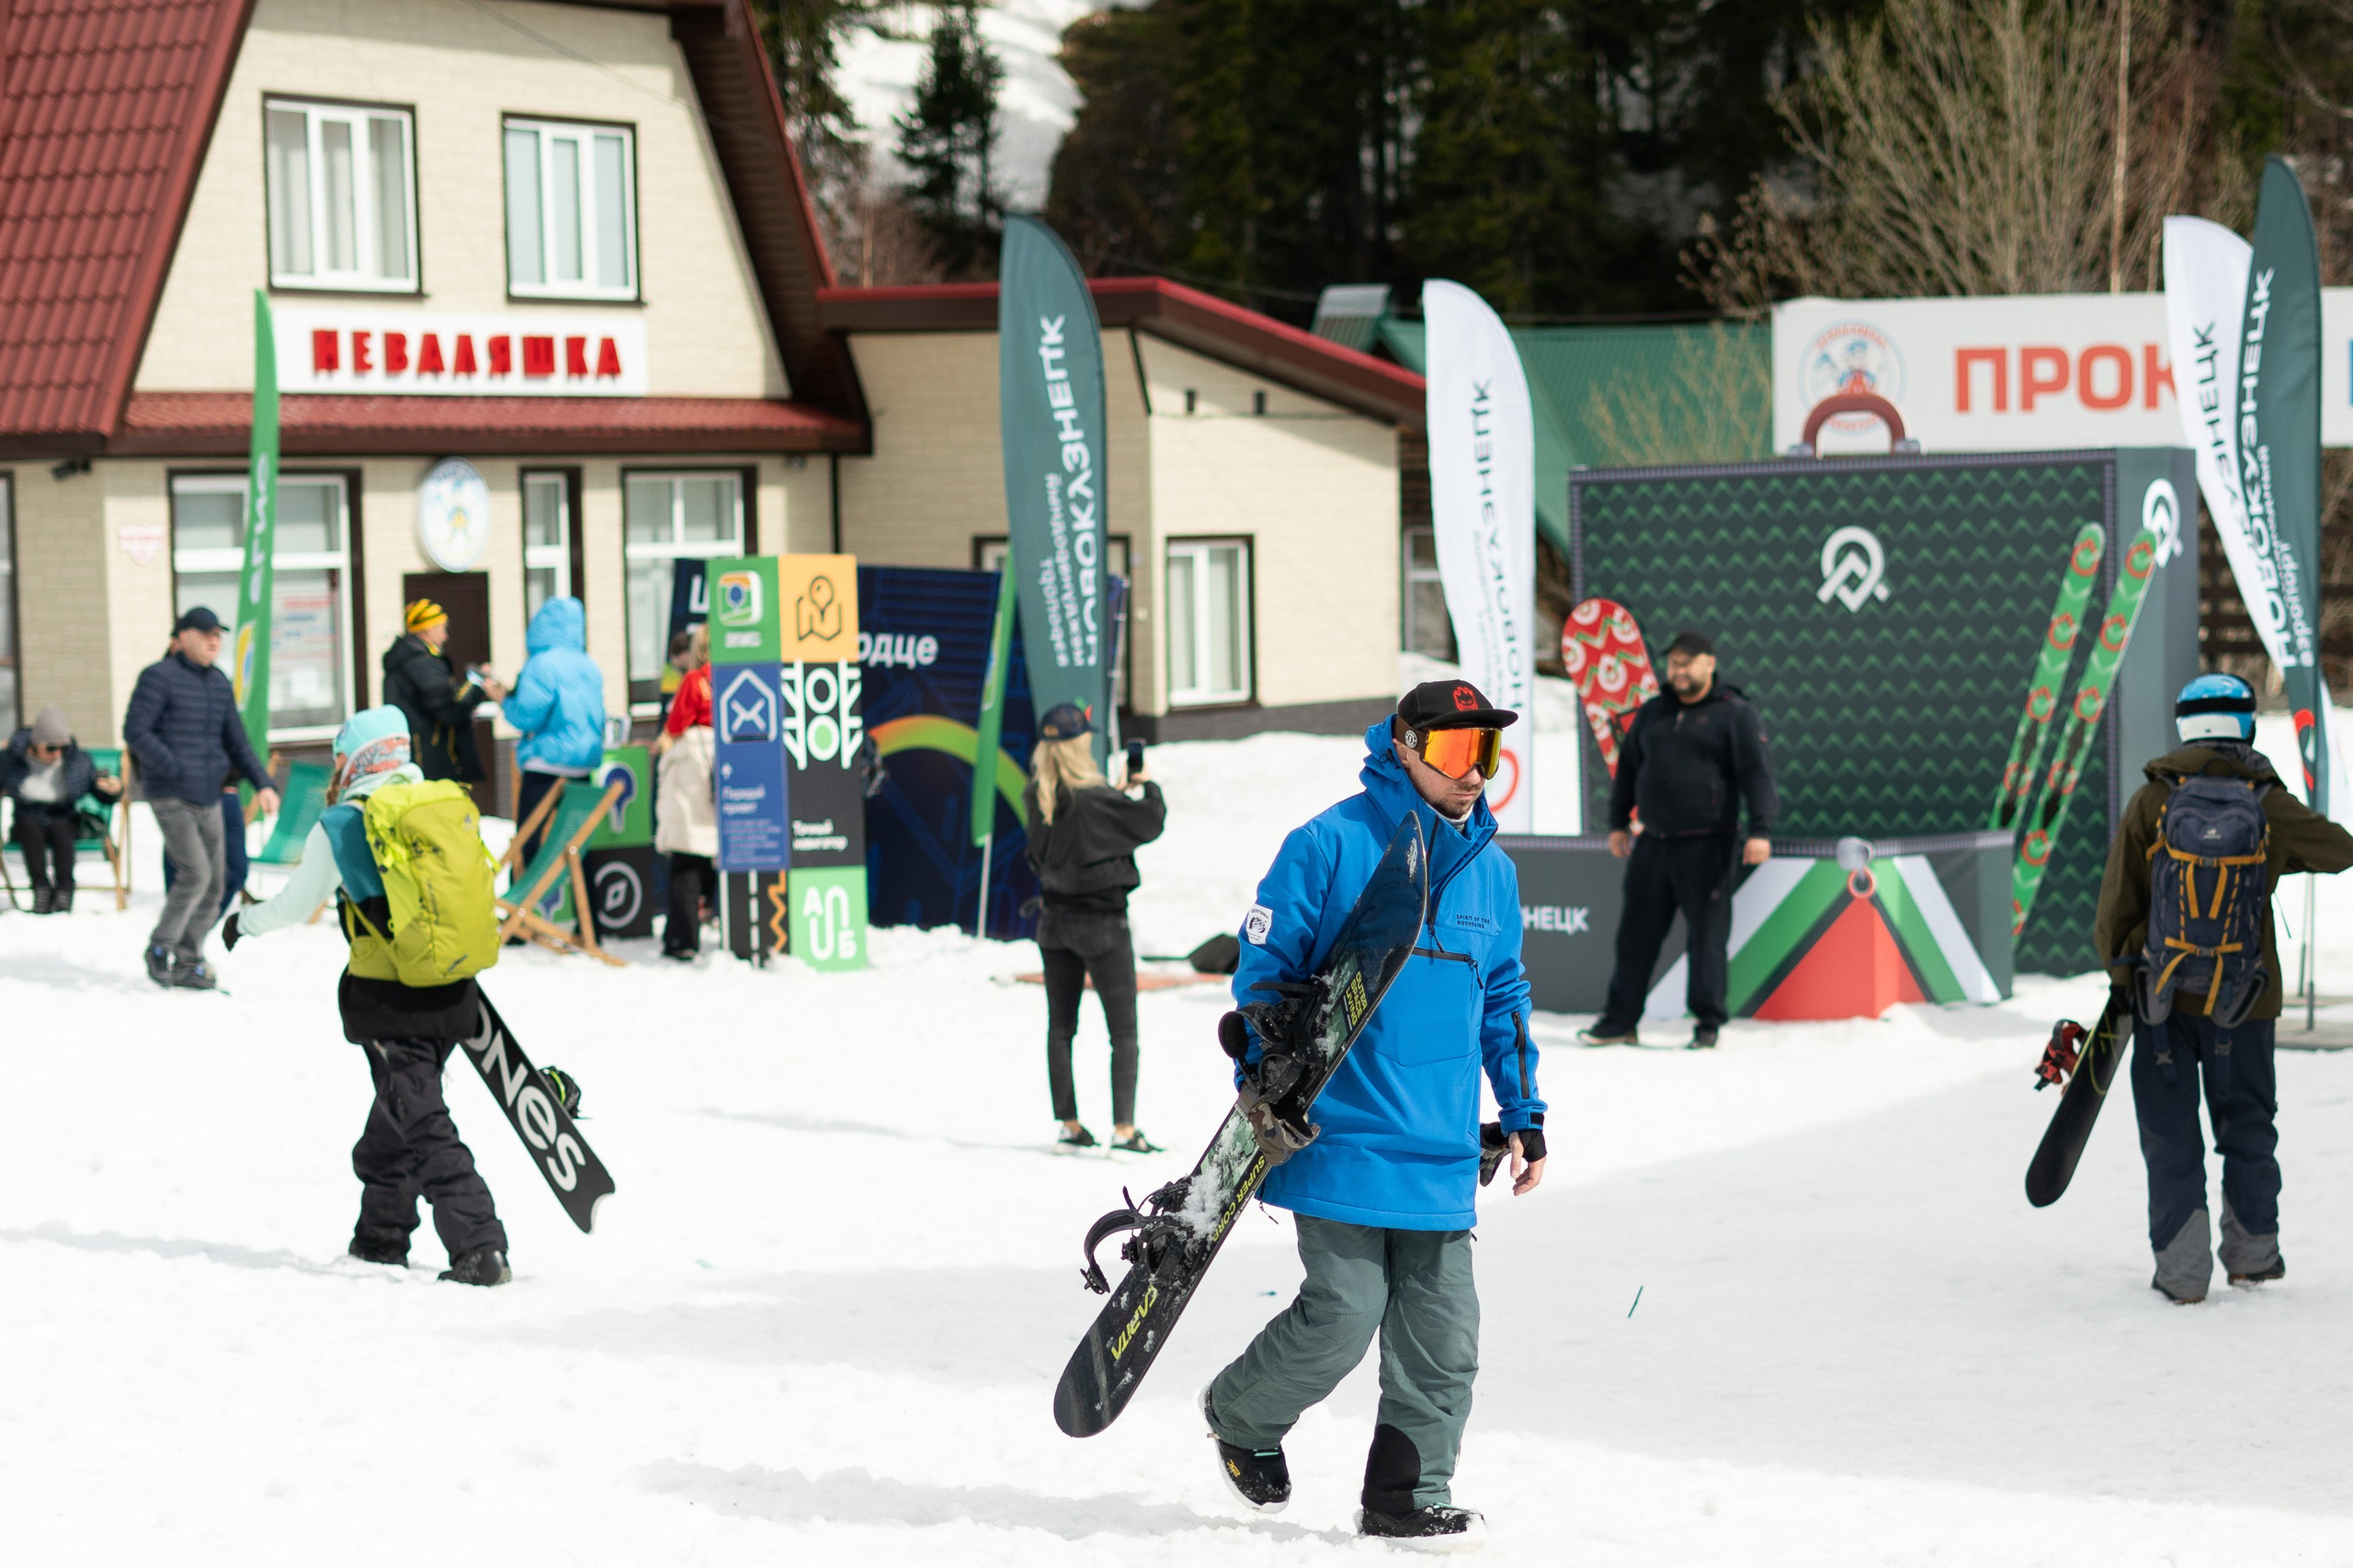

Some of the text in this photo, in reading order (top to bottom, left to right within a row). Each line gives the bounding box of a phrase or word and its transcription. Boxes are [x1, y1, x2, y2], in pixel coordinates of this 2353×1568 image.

[312, 329, 622, 377] НЕВАЛЯШКА
[2279, 541, 2314, 668] аэропорт
[1457, 920, 1484, 928] MOUNTAINS
[1523, 906, 1589, 936] НЕЦК
[1346, 985, 1358, 1026] LIVING
[1350, 978, 1363, 1018] SPACE
[1356, 971, 1368, 1011] OUTER
[1236, 1154, 1266, 1203] SUPER
